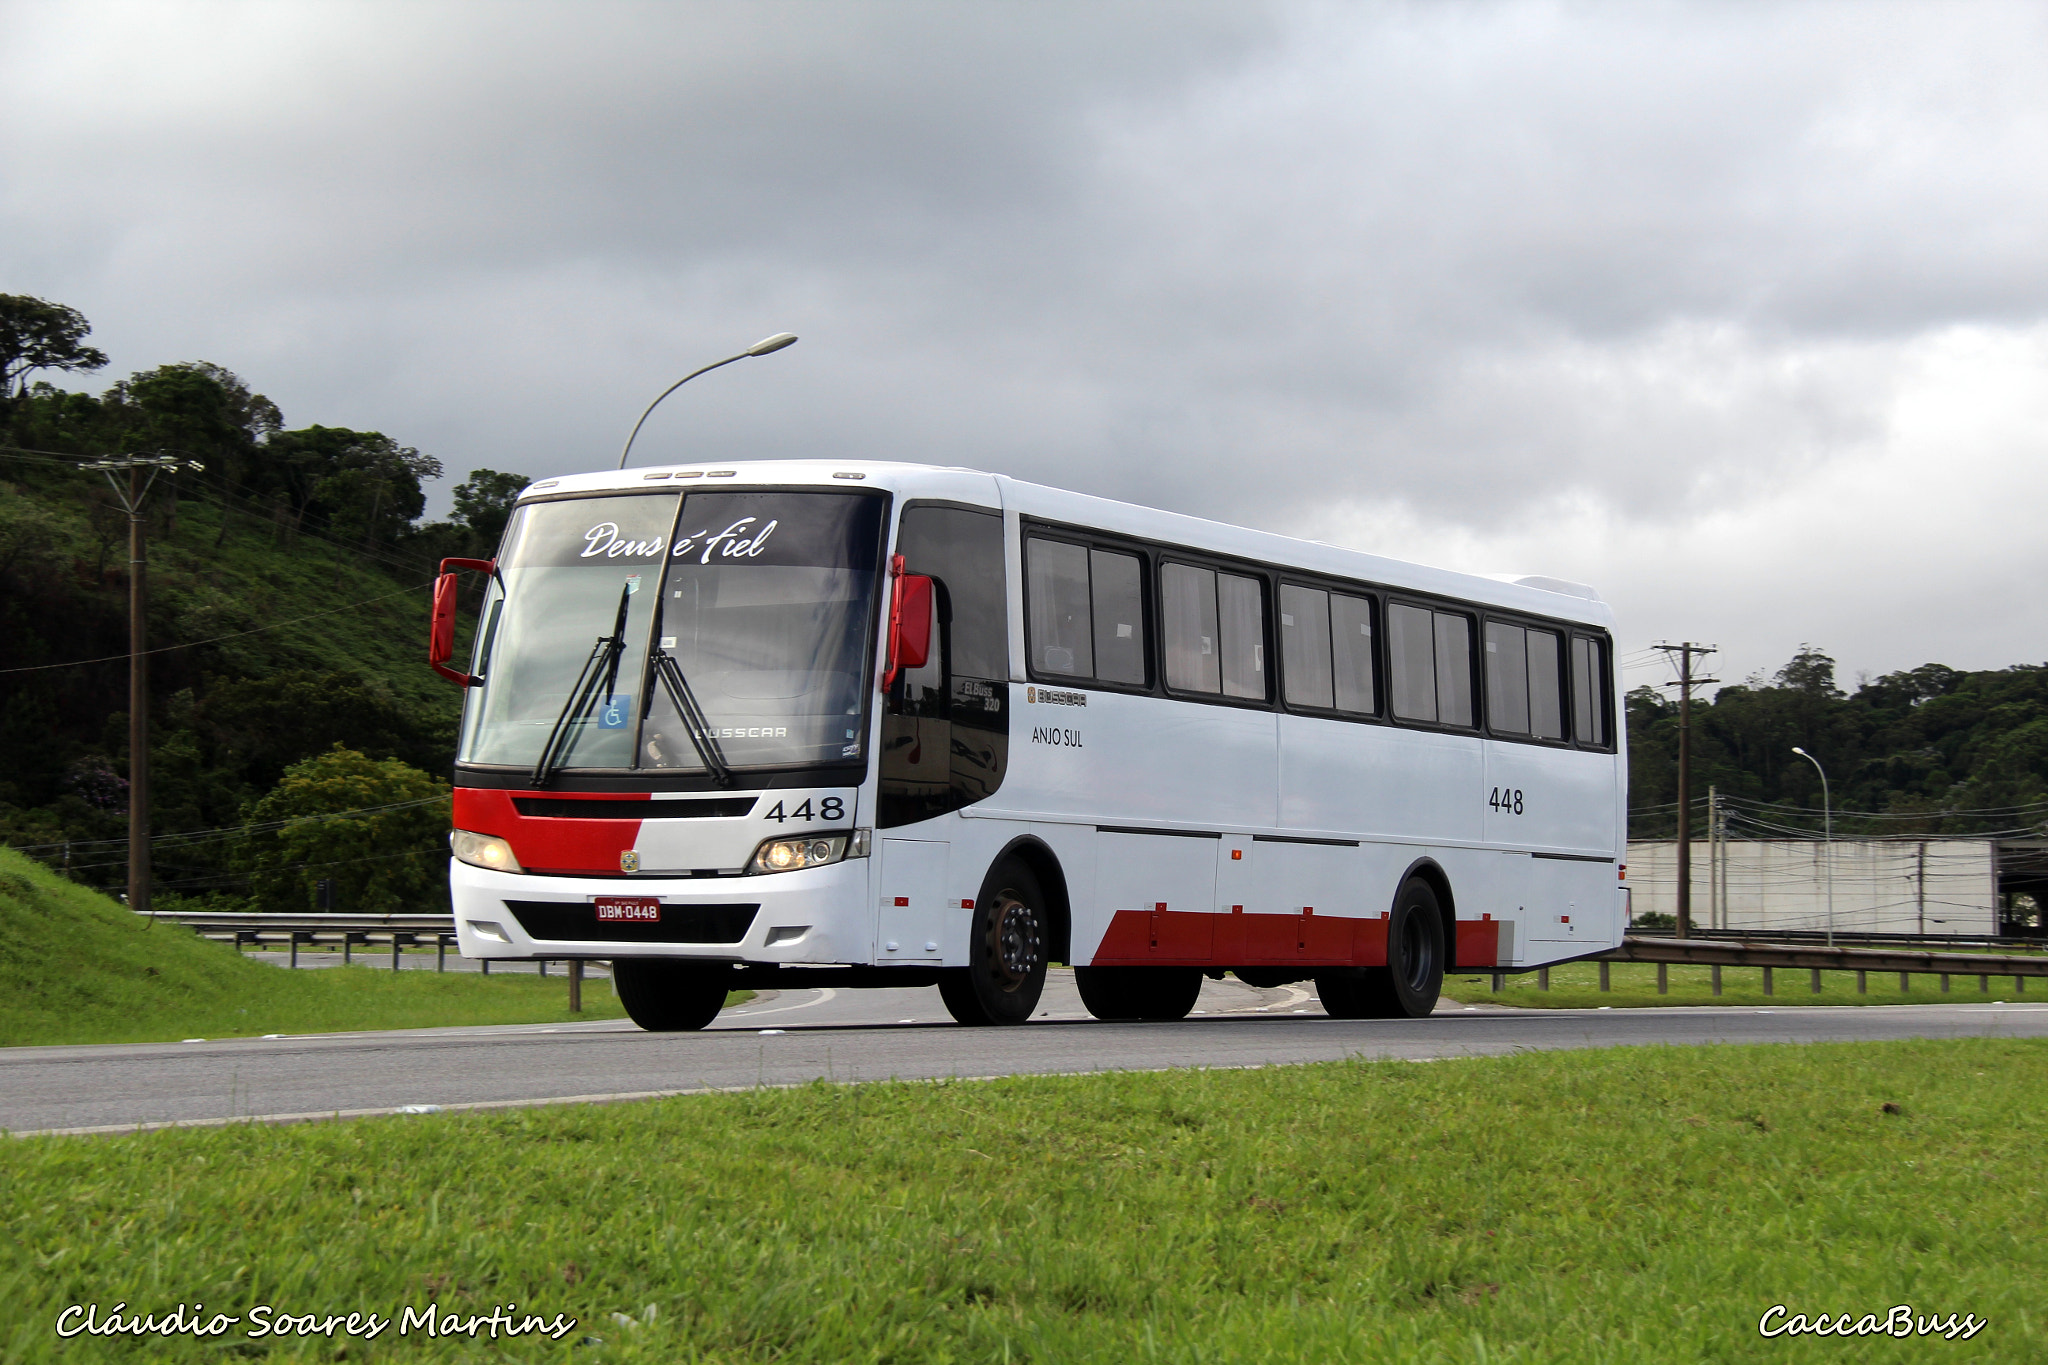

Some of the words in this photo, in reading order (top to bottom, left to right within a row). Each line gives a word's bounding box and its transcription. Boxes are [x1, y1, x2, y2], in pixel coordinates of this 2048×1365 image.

[580, 521, 665, 558] Deus
[672, 529, 707, 557] é
[984, 697, 1001, 713] 320
[1037, 688, 1087, 708] BUSSCAR
[1032, 726, 1061, 746] ANJO
[1064, 728, 1083, 748] SUL
[763, 796, 845, 824] 448
[1488, 786, 1524, 815] 448
